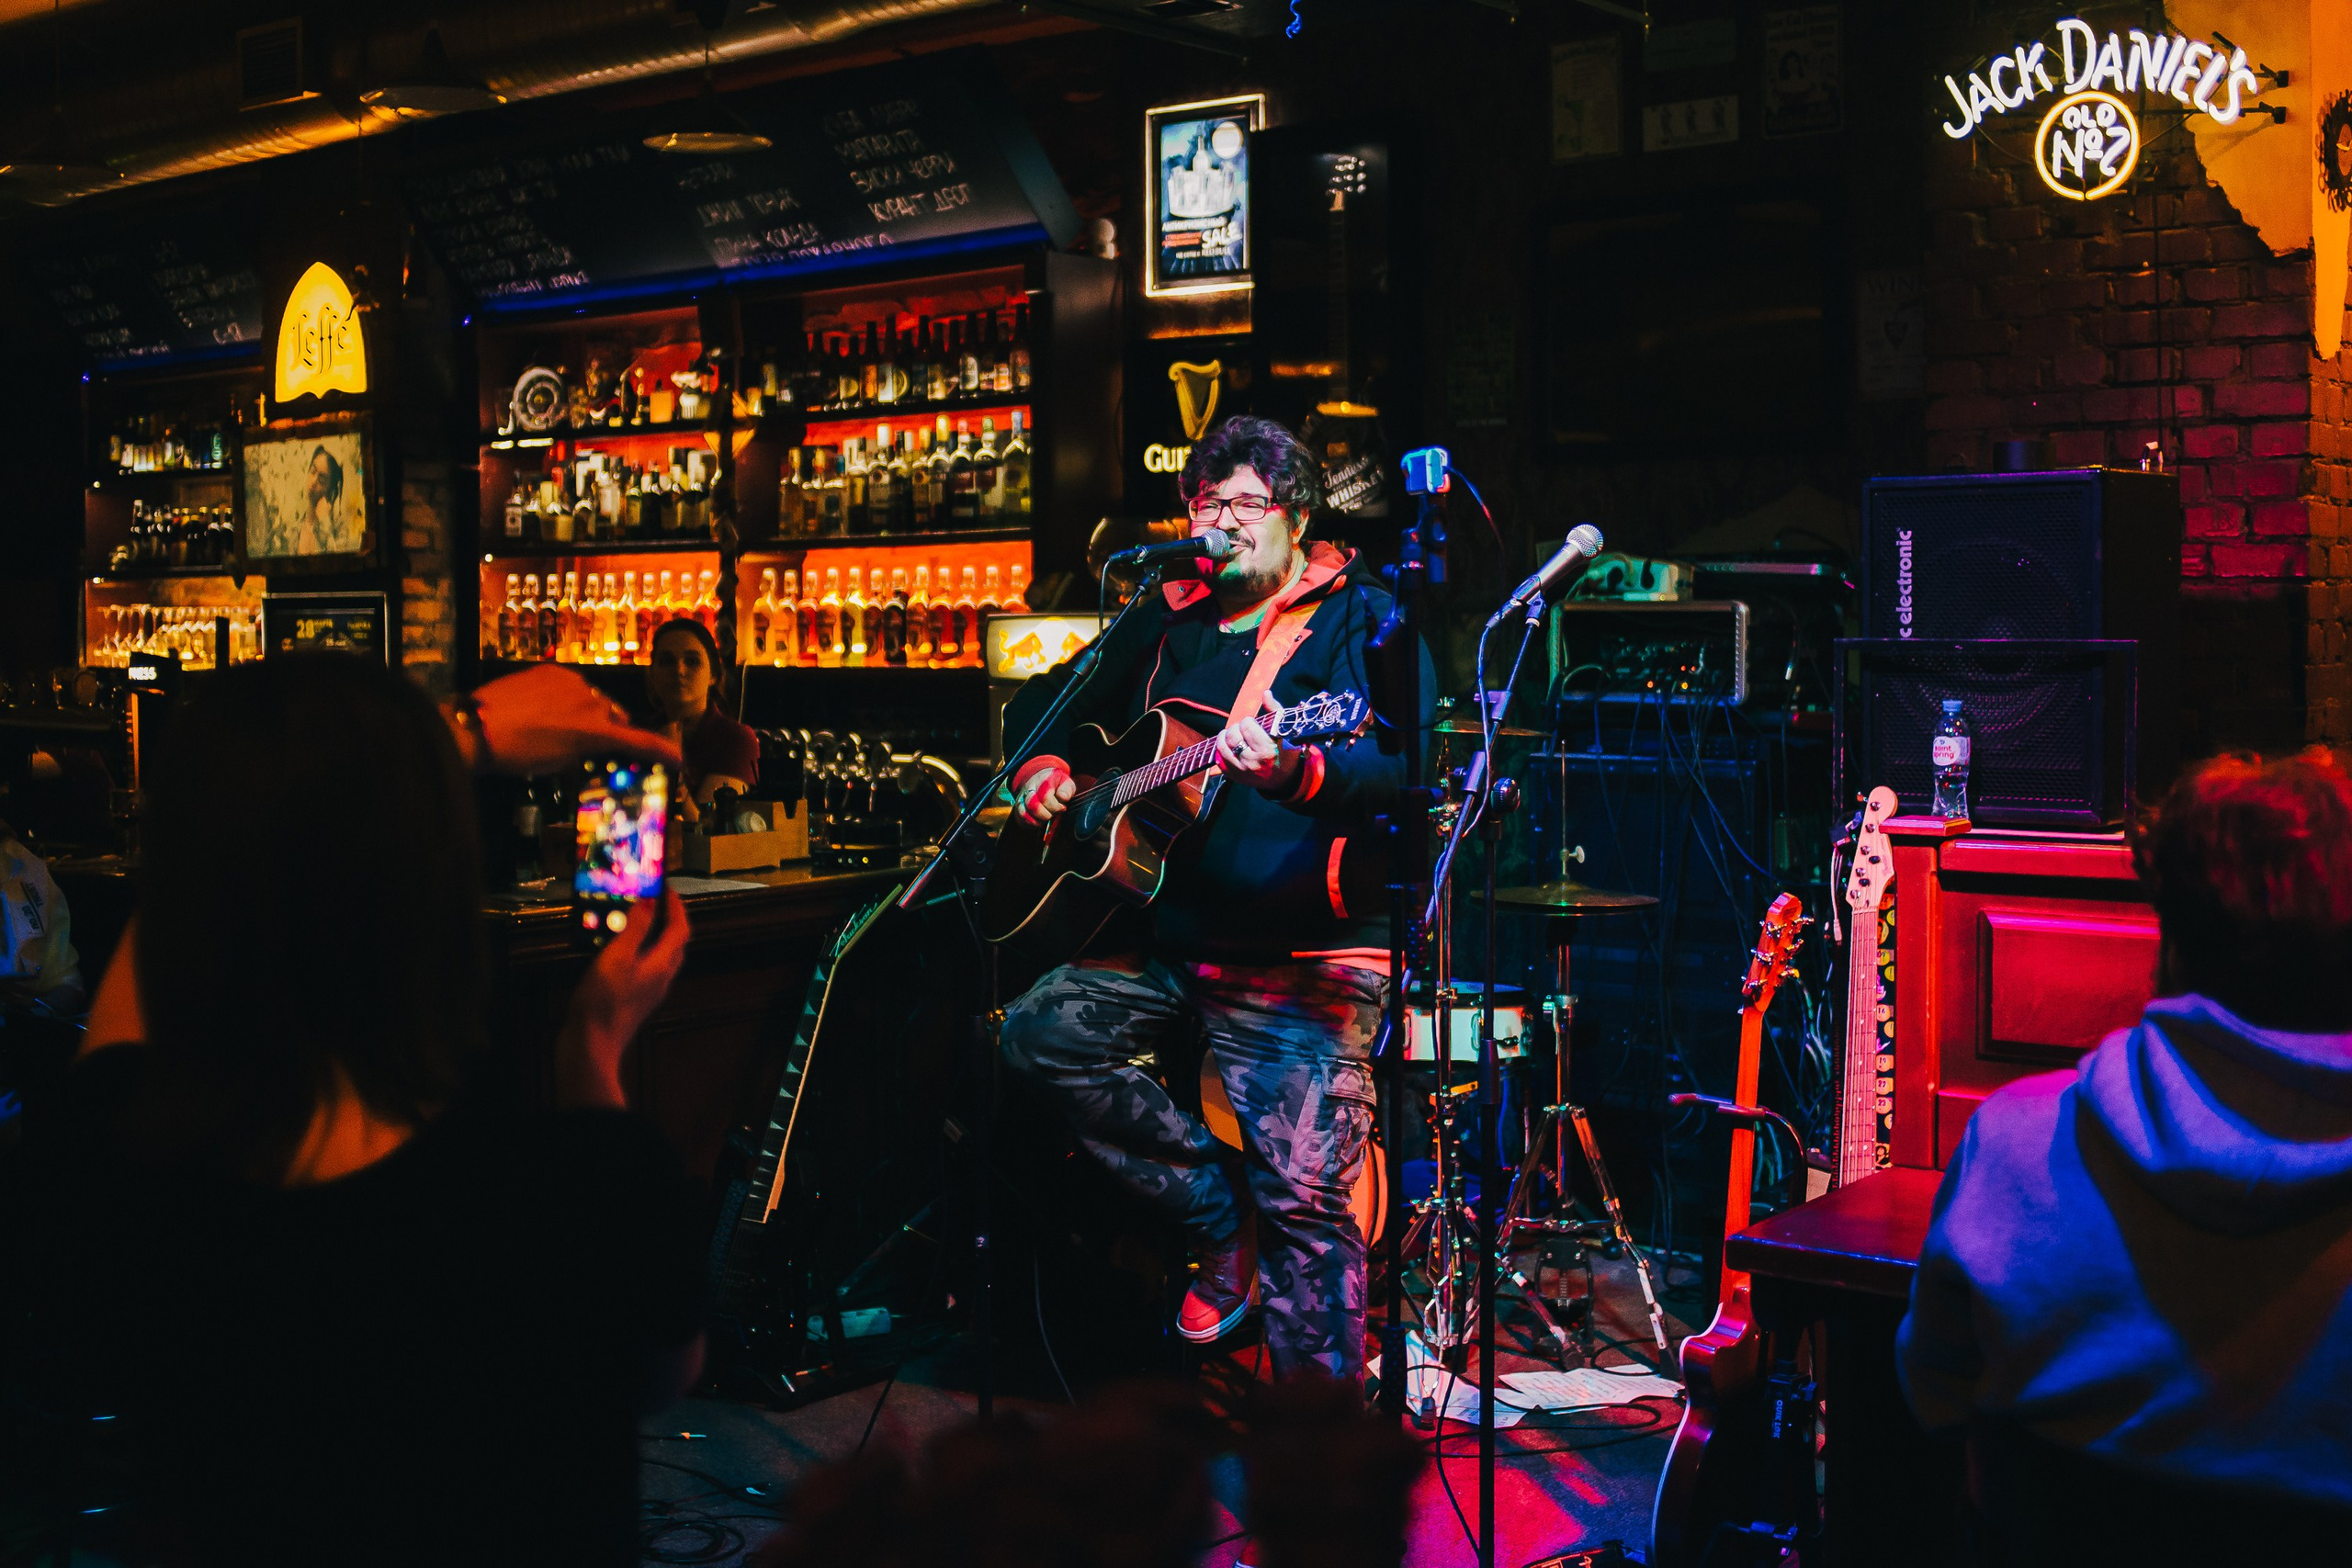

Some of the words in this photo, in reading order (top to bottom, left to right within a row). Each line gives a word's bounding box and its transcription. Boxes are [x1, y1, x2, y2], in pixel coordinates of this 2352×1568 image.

[1943, 42, 2053, 139] JACK
[2056, 18, 2259, 125] DANIEL'S
[2062, 102, 2117, 130] OLD
[1202, 220, 1243, 249] SALE
[1895, 529, 1913, 626] electronic
[1774, 1399, 1783, 1418] QUIK
